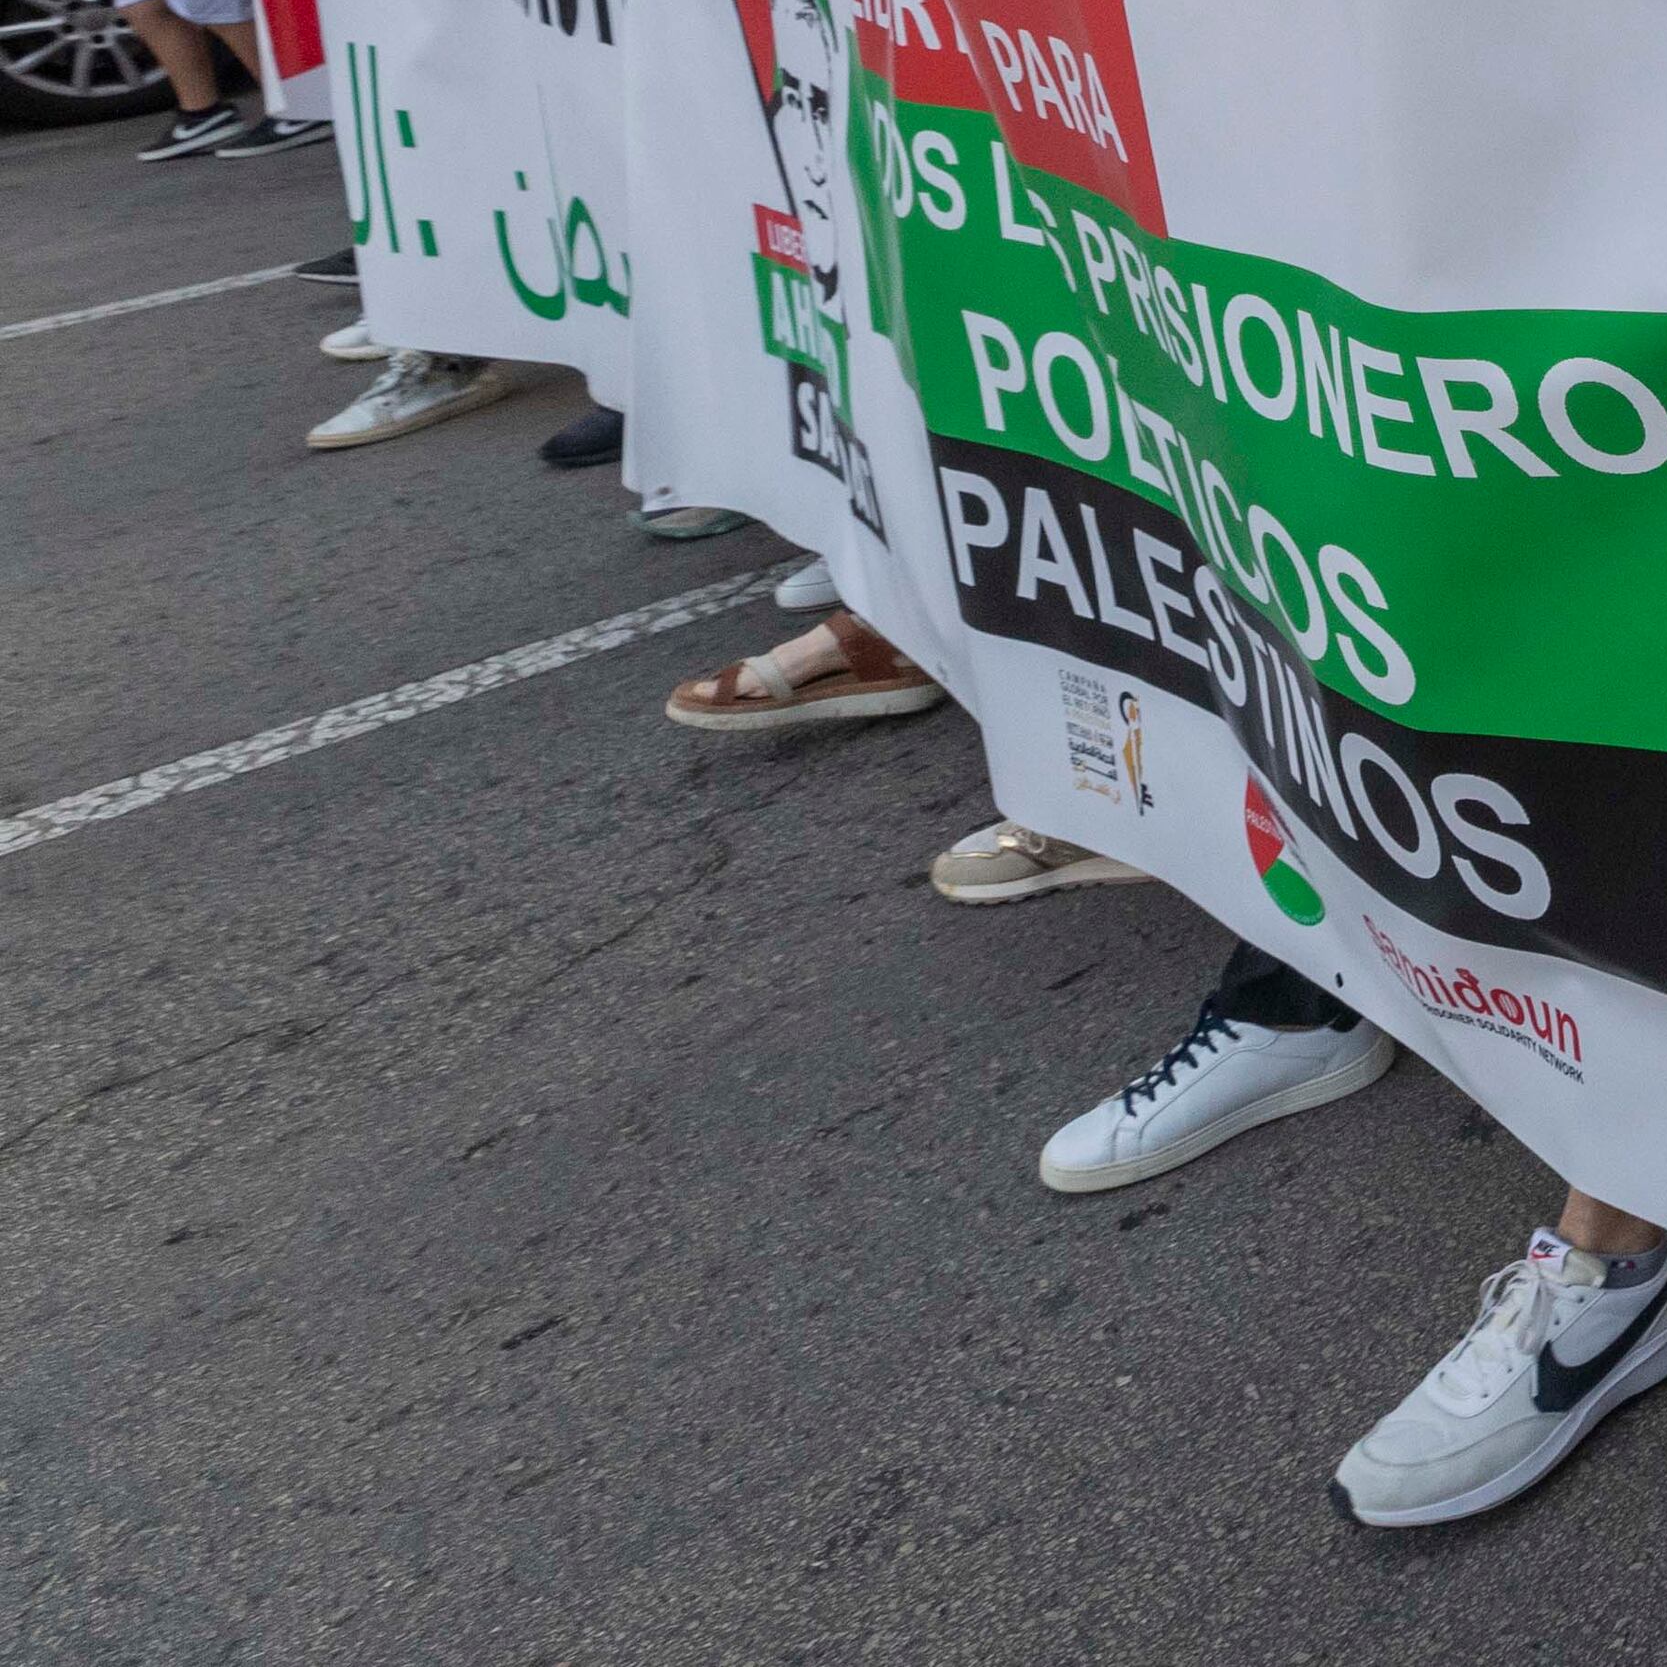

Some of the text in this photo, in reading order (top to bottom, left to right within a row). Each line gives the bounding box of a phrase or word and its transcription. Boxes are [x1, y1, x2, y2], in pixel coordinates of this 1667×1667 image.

[979, 19, 1130, 163] PARA
[938, 466, 1553, 919] PALESTINOS
[1476, 1017, 1538, 1053] SOLIDARITY
[1537, 1045, 1585, 1085] NETWORK
